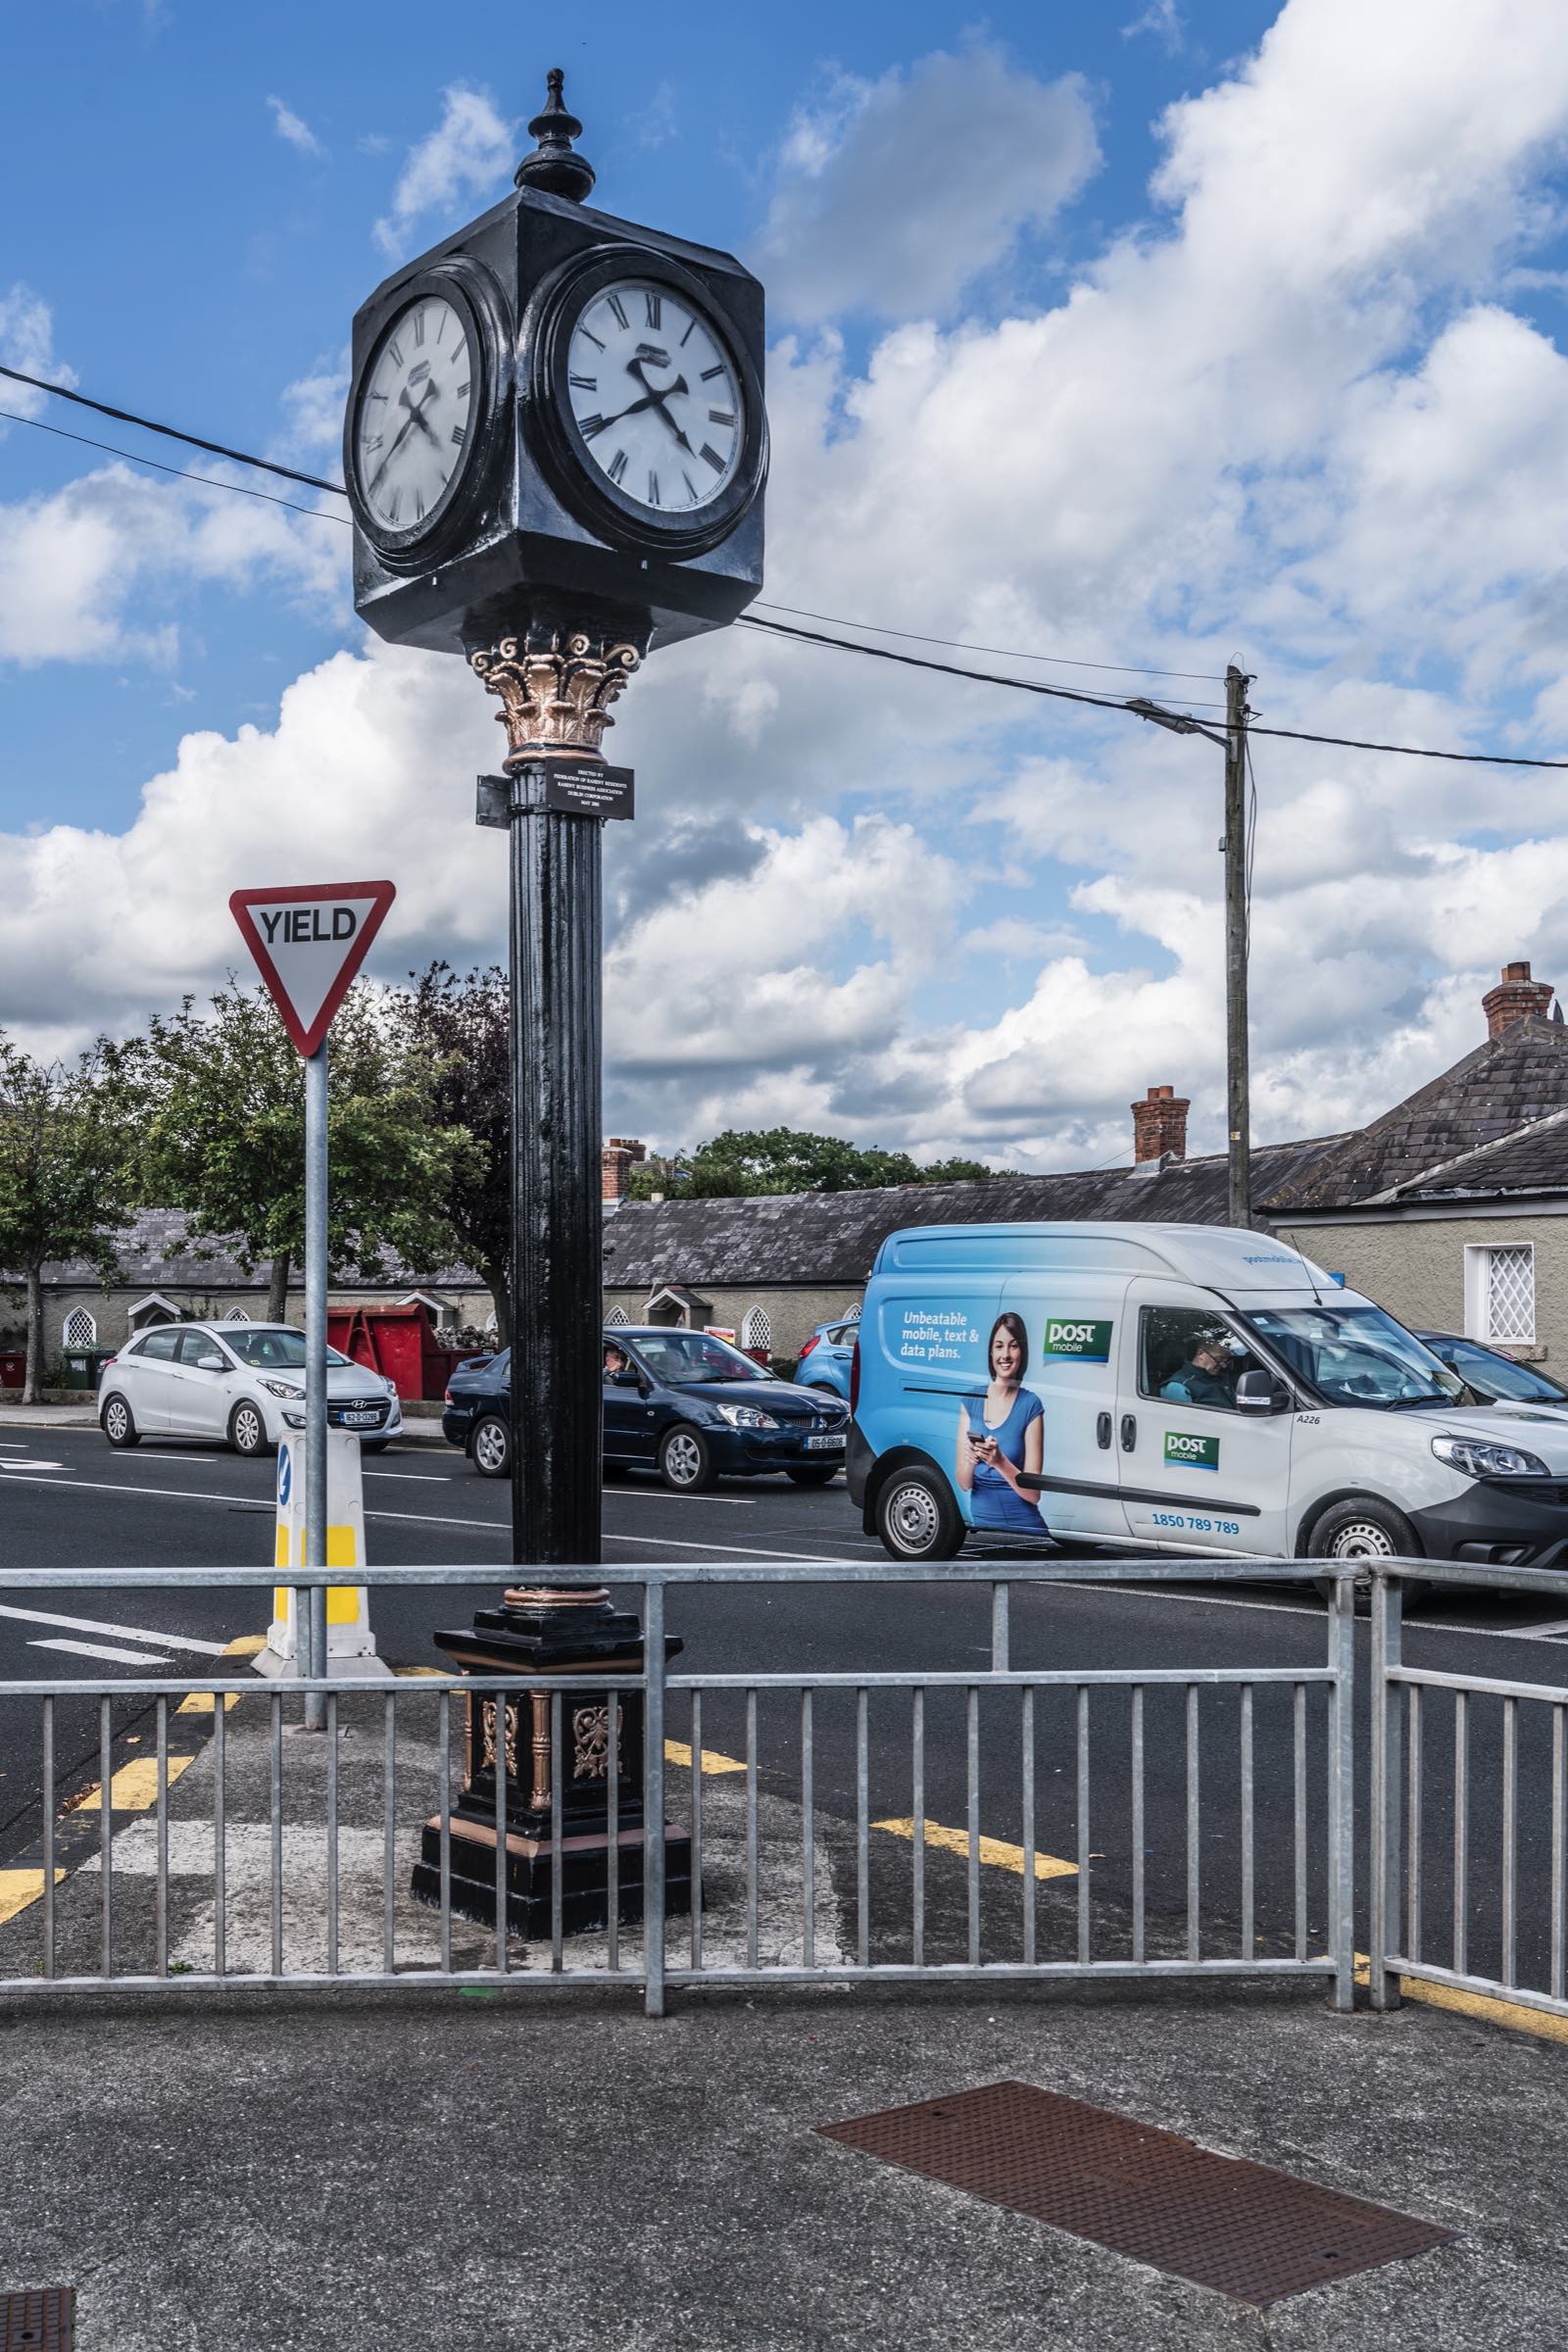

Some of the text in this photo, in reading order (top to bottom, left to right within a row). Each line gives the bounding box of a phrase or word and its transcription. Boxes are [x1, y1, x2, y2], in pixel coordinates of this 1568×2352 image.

[607, 295, 630, 332] XI
[646, 294, 662, 330] XII
[260, 907, 357, 944] YIELD
[904, 1310, 967, 1326] Unbeatable
[902, 1327, 979, 1343] mobile, text &
[901, 1343, 960, 1361] data plans.
[1053, 1342, 1083, 1352] mobile
[1297, 1415, 1321, 1425] A226
[1170, 1450, 1198, 1460] mobile
[1152, 1513, 1240, 1535] 1850 789 789
